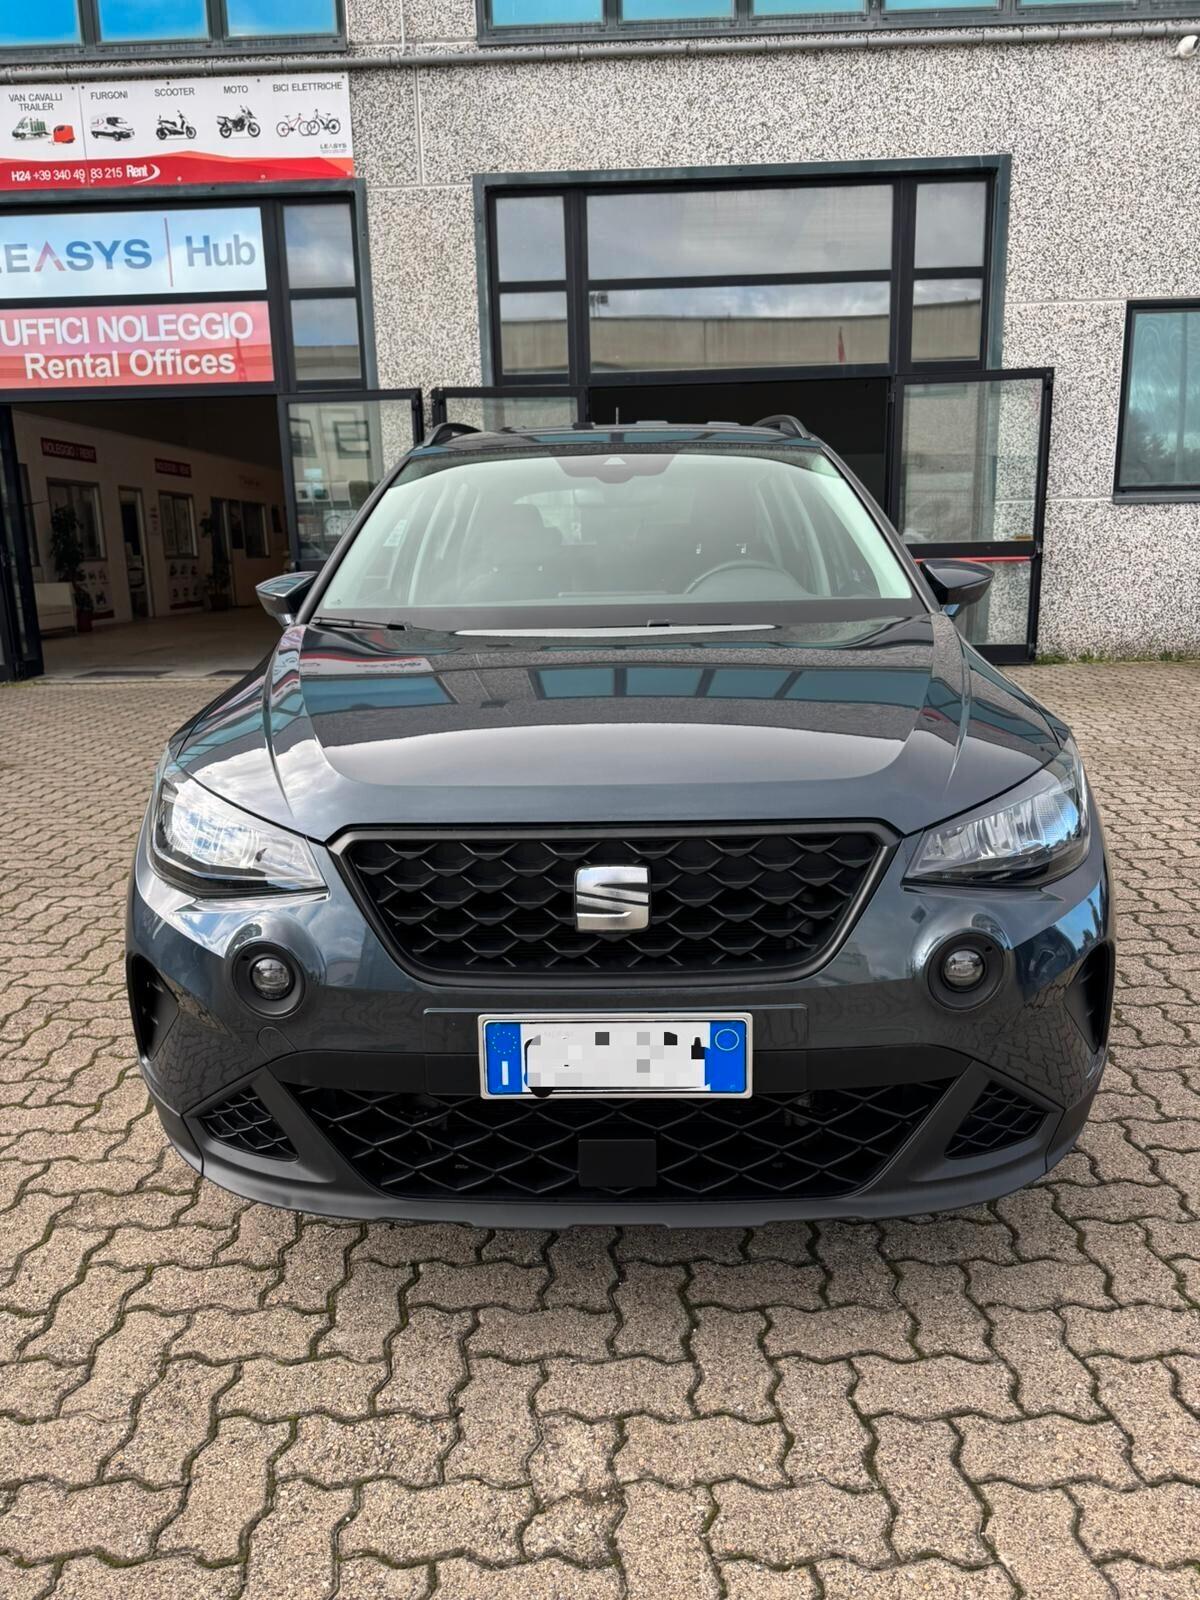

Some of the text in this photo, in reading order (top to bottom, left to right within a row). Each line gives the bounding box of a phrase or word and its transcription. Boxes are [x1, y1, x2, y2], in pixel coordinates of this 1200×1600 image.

[223, 85, 249, 94] MOTO
[272, 81, 343, 92] BICI ELETTRICHE
[90, 90, 128, 100] FURGONI
[154, 87, 195, 97] SCOOTER
[8, 93, 63, 102] VAN CAVALLI
[19, 103, 54, 111] TRAILER
[11, 165, 149, 182] H24 +39 340 49 83 215 Rent
[0, 233, 256, 274] EASYS Hub
[1, 311, 254, 346] UFFICI NOLEGGIO
[24, 348, 236, 380] Rental Offices
